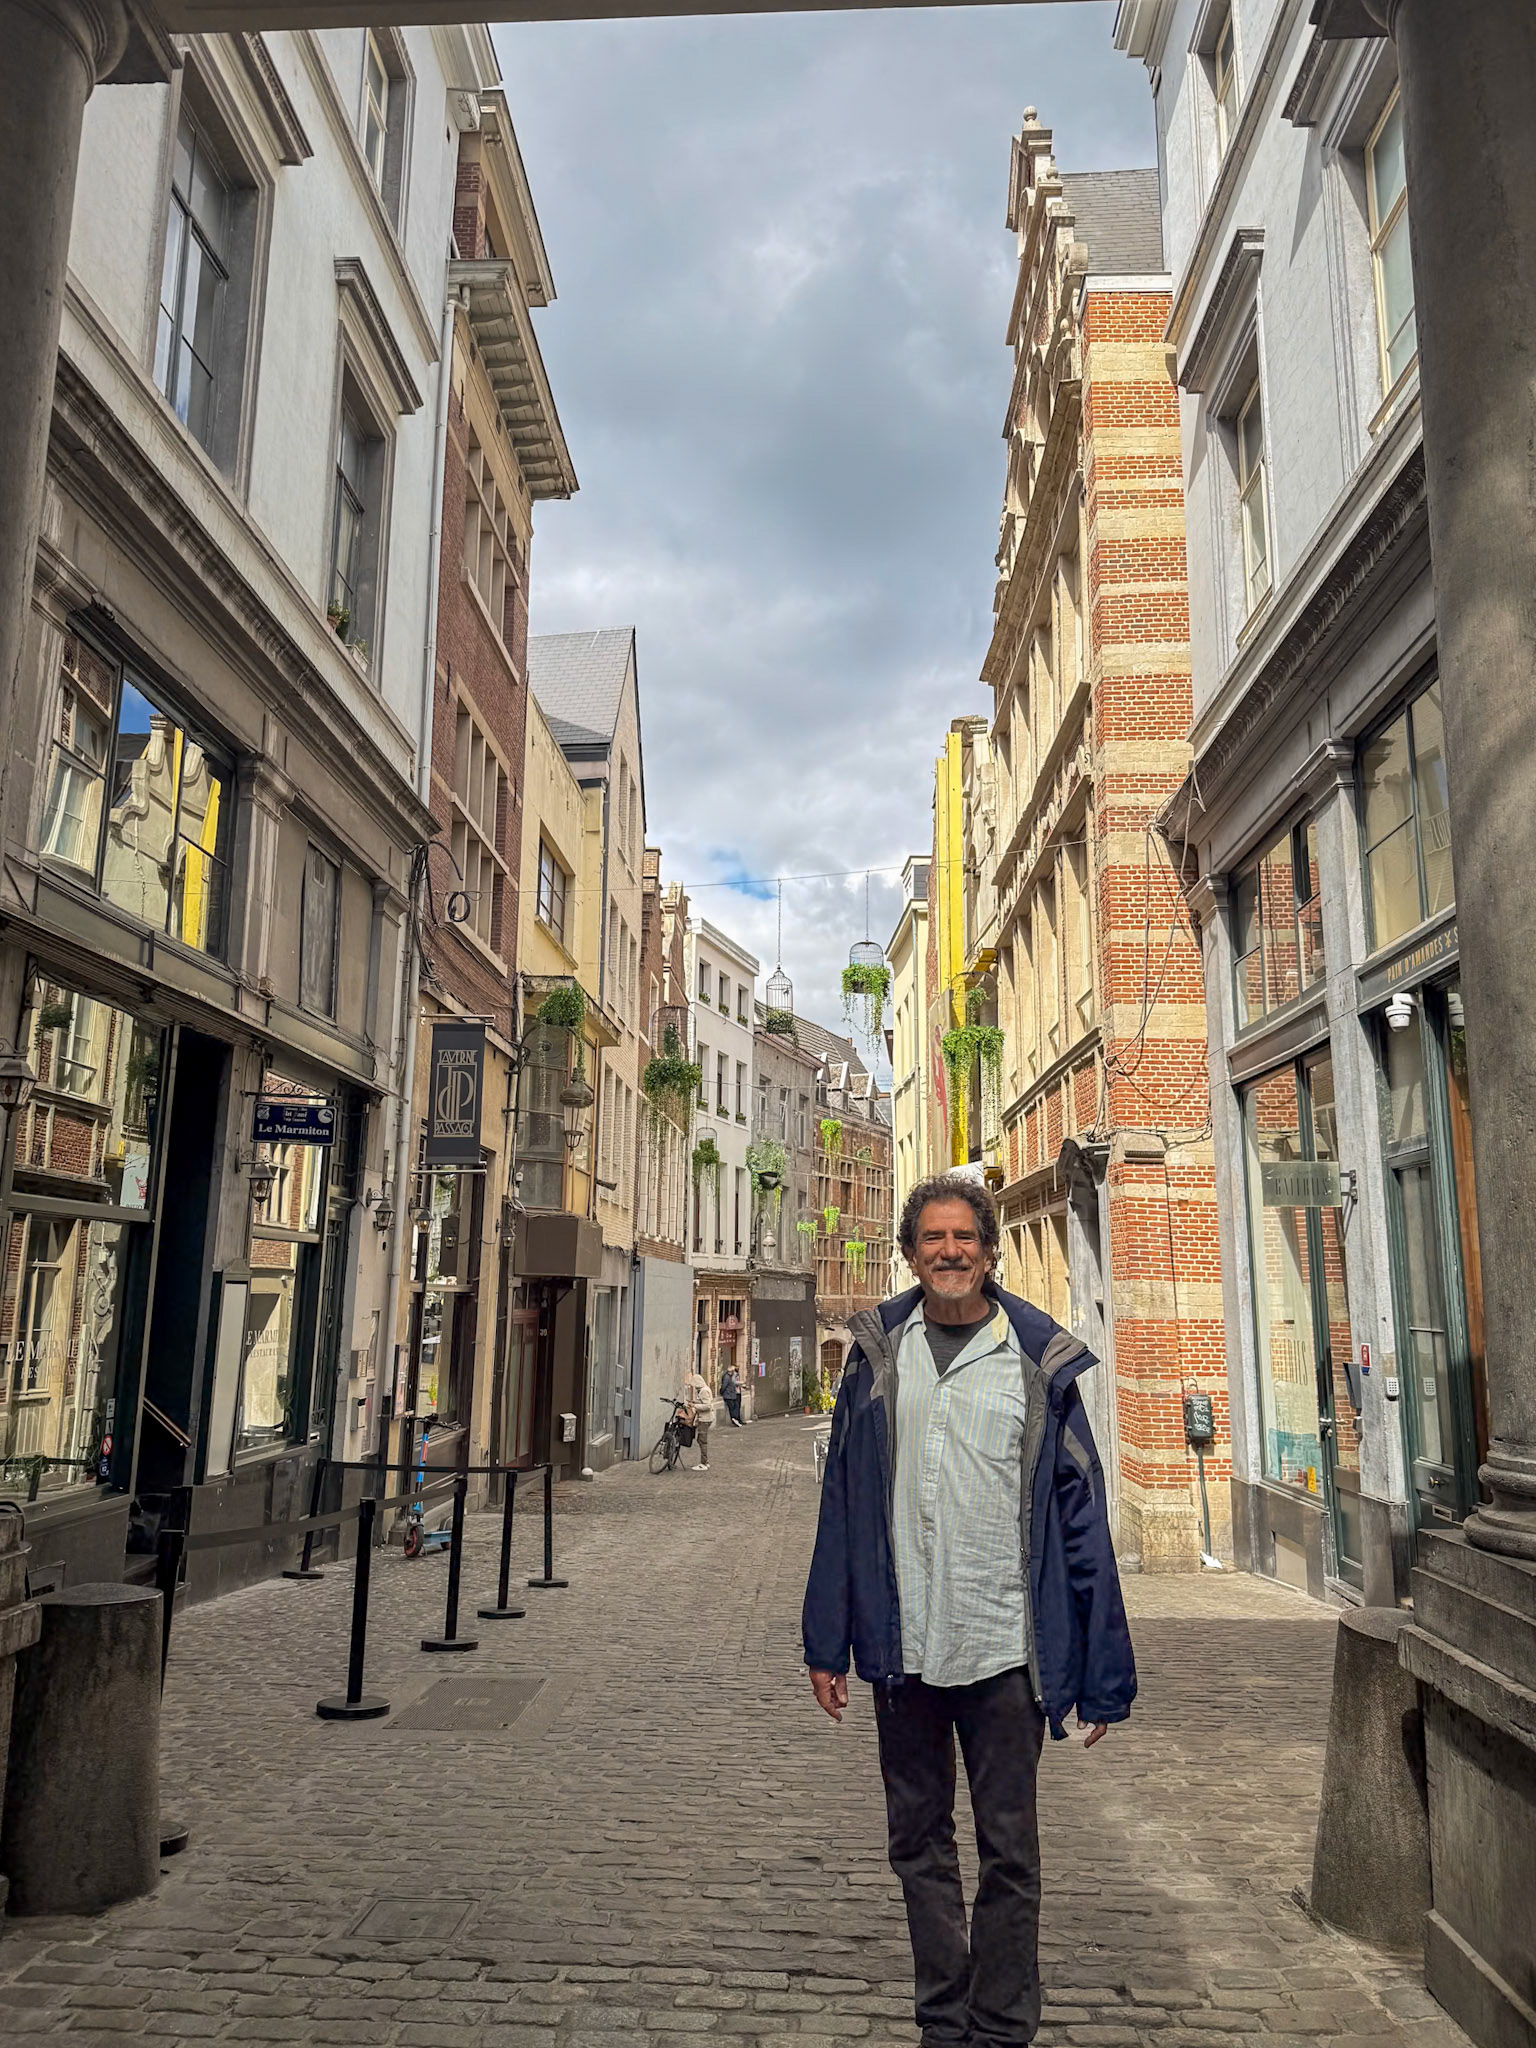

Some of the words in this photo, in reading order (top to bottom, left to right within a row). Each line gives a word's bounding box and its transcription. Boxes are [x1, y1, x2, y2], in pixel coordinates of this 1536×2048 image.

[438, 1050, 478, 1064] TAVERNE
[258, 1123, 273, 1133] Le
[274, 1124, 330, 1136] Marmiton
[433, 1121, 474, 1135] PASSAGE
